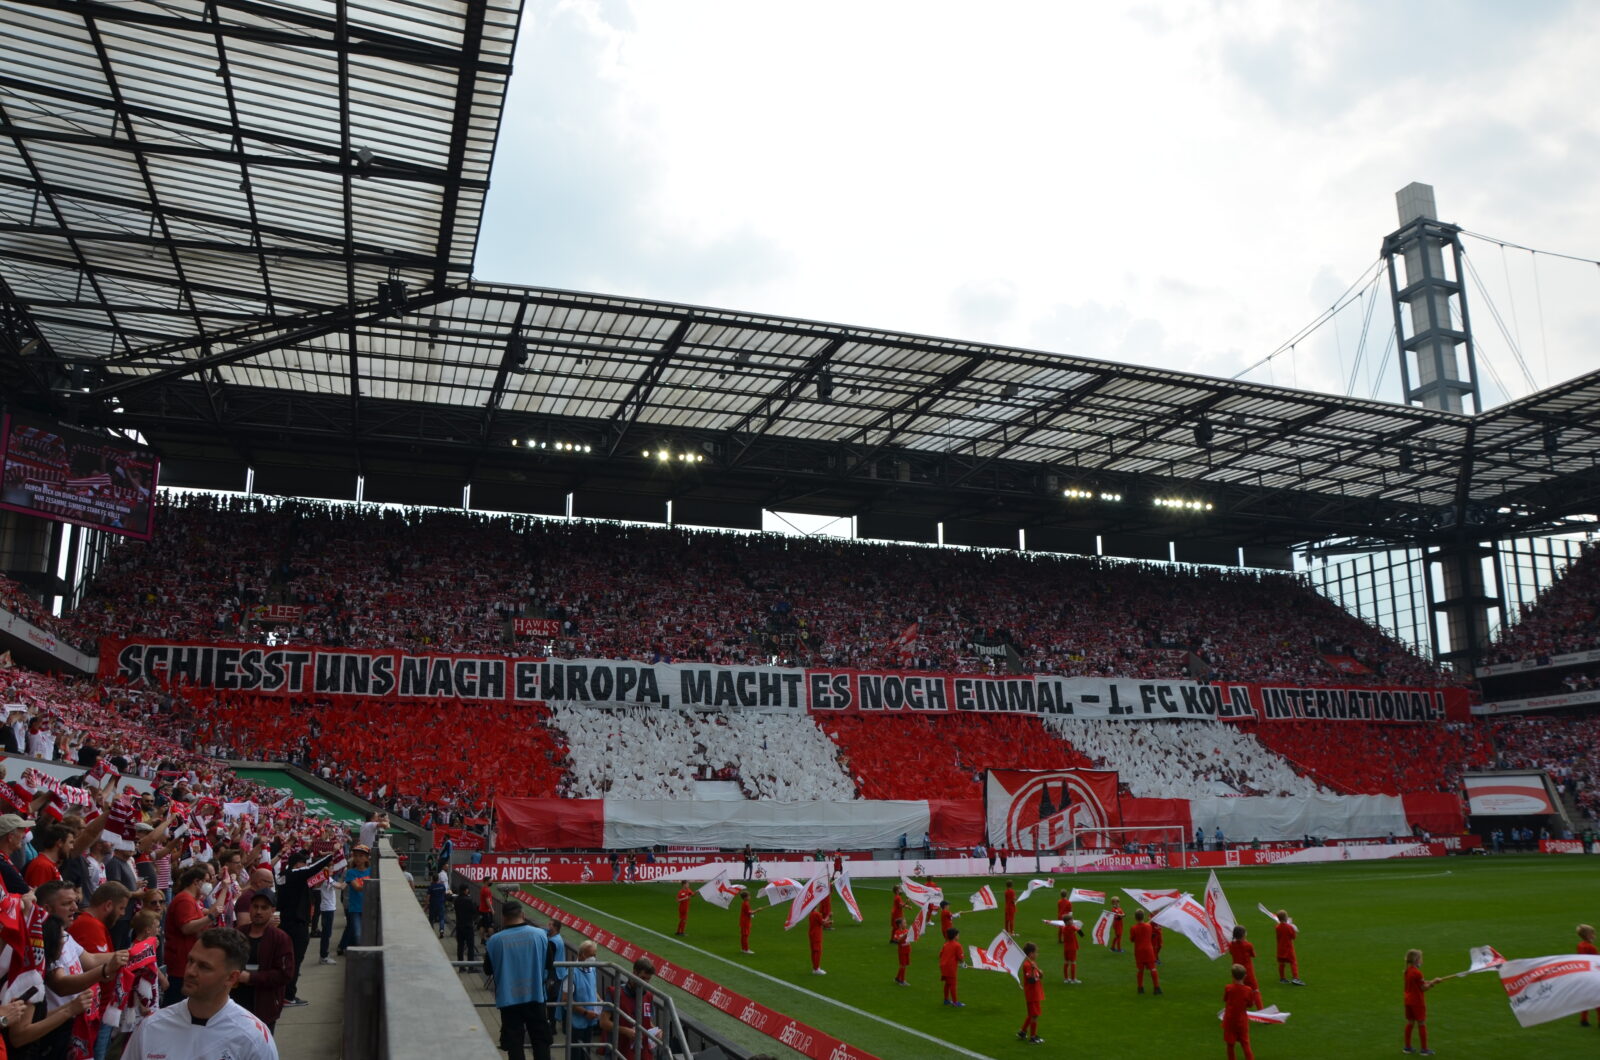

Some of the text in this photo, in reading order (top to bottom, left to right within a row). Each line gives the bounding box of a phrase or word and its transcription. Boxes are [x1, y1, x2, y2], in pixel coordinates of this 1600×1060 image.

[514, 619, 559, 633] HAWKS
[973, 643, 1007, 656] TROIKA
[119, 644, 312, 692] SCHIESST
[316, 653, 394, 695] UNS
[400, 656, 505, 700] NACH
[515, 662, 670, 709] EUROPA,
[681, 669, 802, 707] MACHT
[810, 673, 852, 711] ES
[858, 675, 948, 711] NOCH
[955, 677, 1074, 714] EINMAL
[1108, 684, 1133, 714] 1.
[1139, 685, 1177, 713] FC
[1261, 687, 1446, 721] INTERNATIONAL!
[501, 866, 551, 881] ANDERS.
[740, 1005, 768, 1030] DERTOUR
[780, 1025, 813, 1054] DERTOUR
